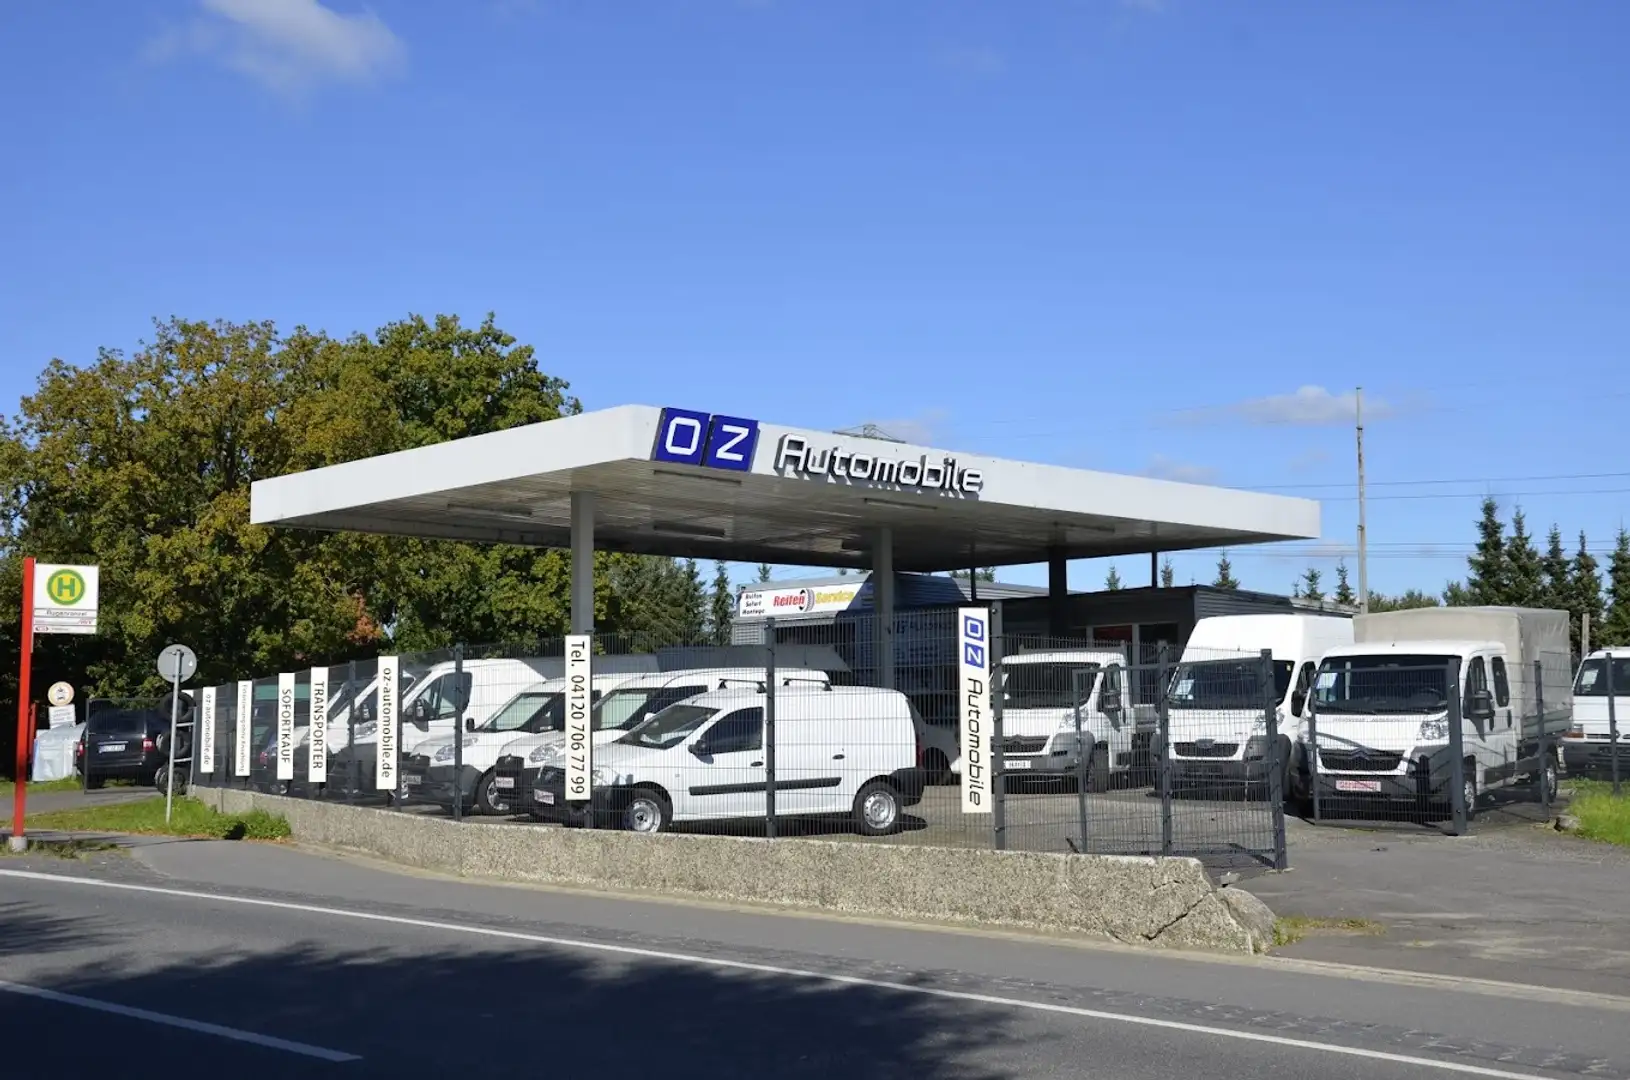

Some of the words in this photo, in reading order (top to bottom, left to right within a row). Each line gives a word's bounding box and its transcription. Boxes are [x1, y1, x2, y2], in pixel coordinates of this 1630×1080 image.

[775, 433, 984, 493] Automobile
[57, 577, 75, 597] H
[773, 593, 805, 607] Reifen
[815, 590, 855, 604] Service
[570, 641, 586, 667] Tel.
[570, 674, 585, 720] 04120
[203, 693, 212, 765] oz-automobile.de
[281, 688, 293, 763] SOFORTKAUF
[312, 680, 325, 769] TRANSPORTER
[381, 667, 394, 778] oz-automobile.de
[570, 723, 585, 751] 706
[966, 677, 985, 806] Automobile
[570, 755, 585, 772] 77
[570, 776, 585, 794] 99
